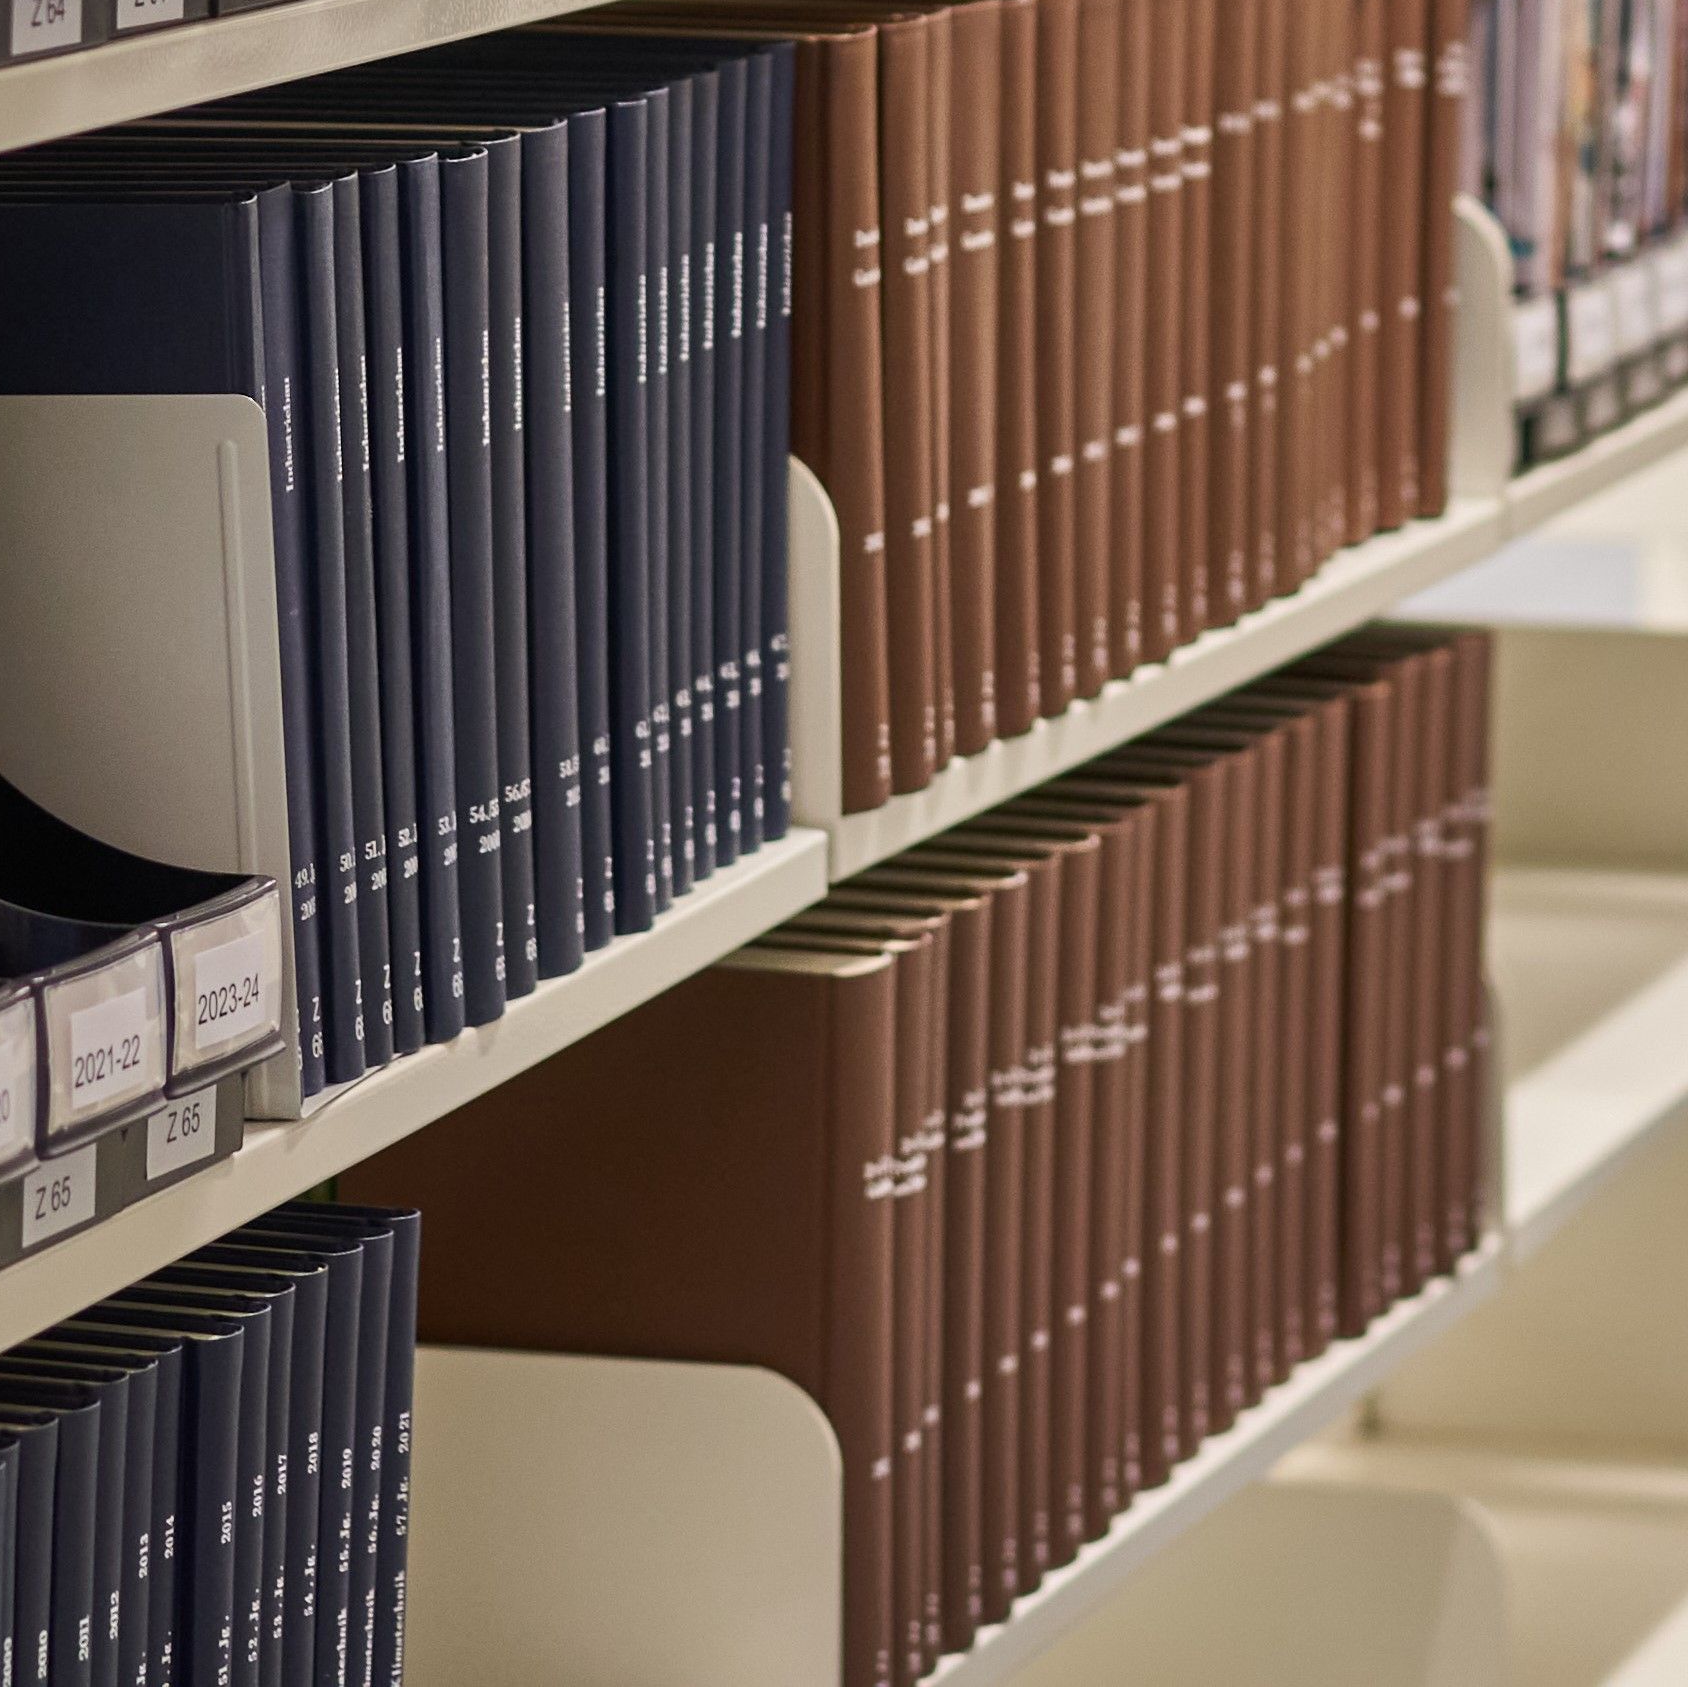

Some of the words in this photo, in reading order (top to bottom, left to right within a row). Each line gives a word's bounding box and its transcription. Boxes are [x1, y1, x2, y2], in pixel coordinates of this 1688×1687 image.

[396, 347, 404, 462] Industriebau
[283, 377, 293, 492] Industriebau
[197, 972, 260, 1027] 2023-24
[75, 1034, 141, 1089] 2021-22
[166, 1112, 179, 1143] Z
[180, 1102, 201, 1137] 65
[35, 1187, 47, 1220] Z
[50, 1176, 72, 1213] 65
[277, 1454, 288, 1495] 2017
[307, 1431, 319, 1474] 2018
[341, 1448, 352, 1489] 2019
[252, 1474, 263, 1517] 2016
[164, 1514, 175, 1559] 2014
[220, 1500, 232, 1544] 2015
[138, 1533, 149, 1579] 2013
[109, 1589, 120, 1640] 2012
[37, 1629, 49, 1680] 2010
[78, 1614, 90, 1661] 2011
